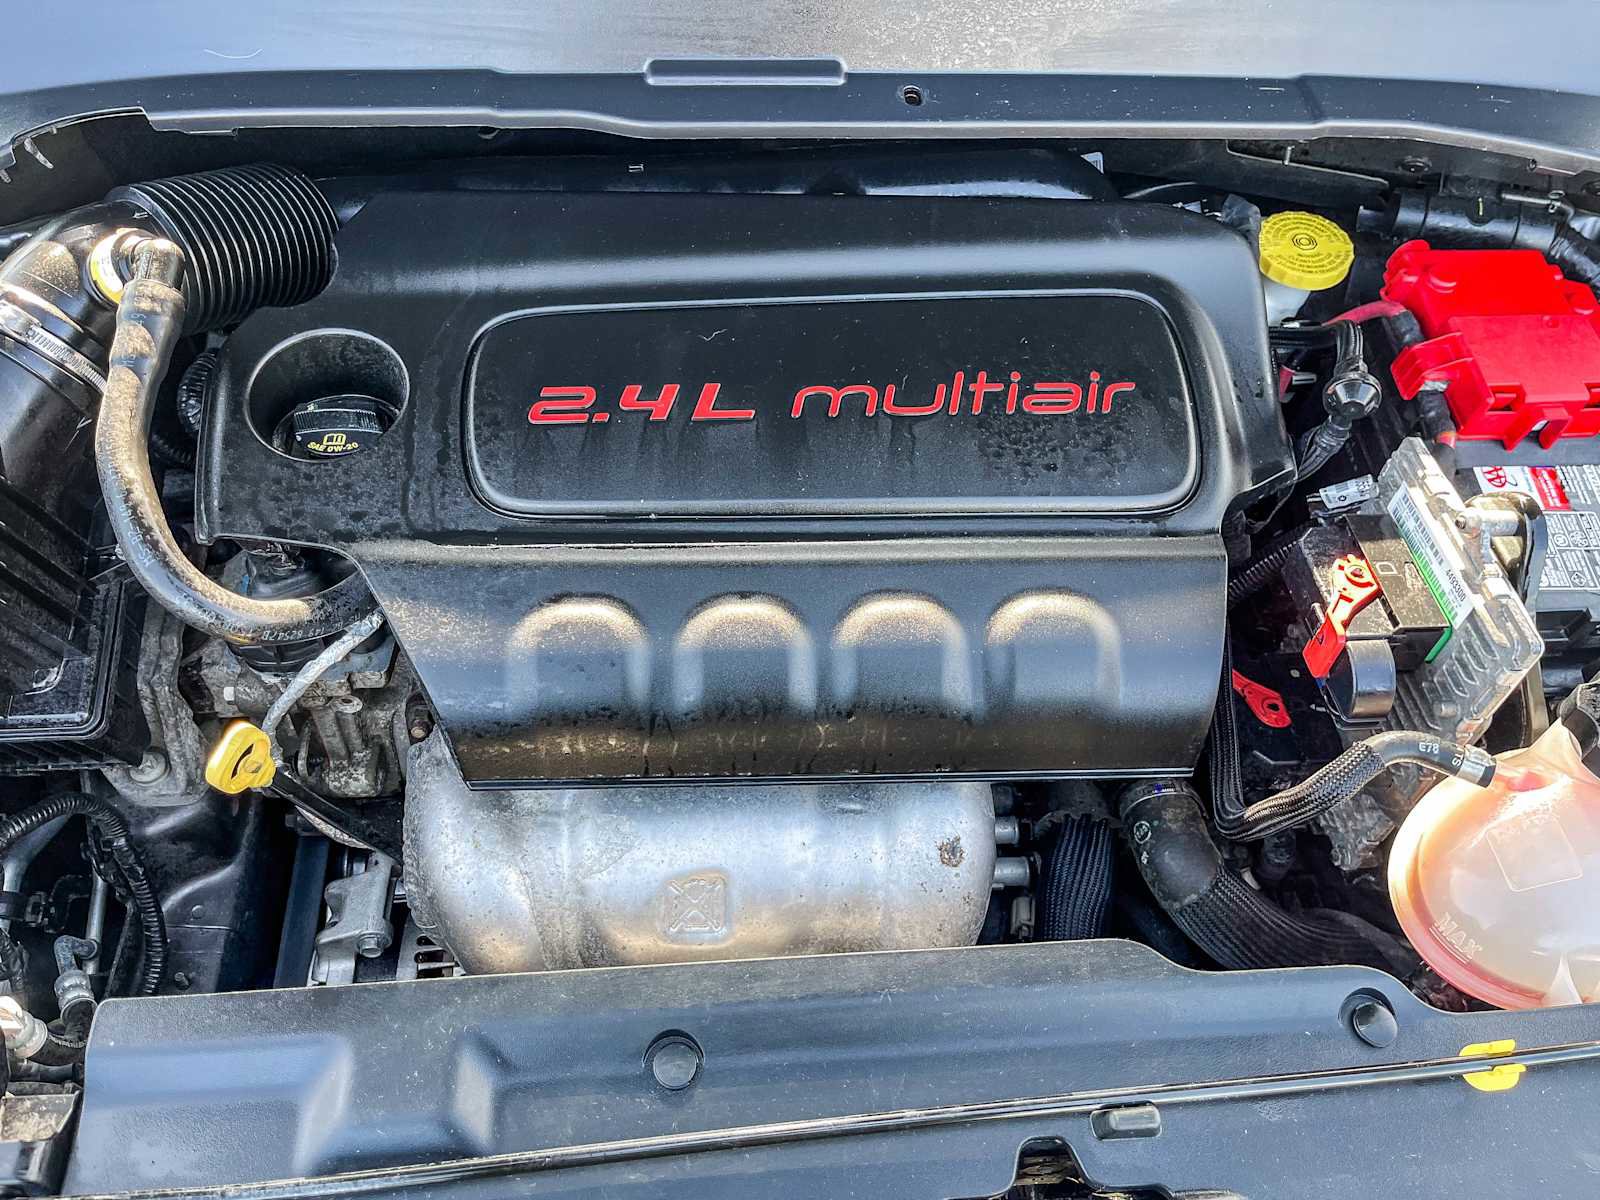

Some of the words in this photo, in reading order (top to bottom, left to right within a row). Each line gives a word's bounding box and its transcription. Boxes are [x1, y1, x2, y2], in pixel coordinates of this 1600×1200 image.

[791, 370, 1137, 419] multiair
[307, 441, 327, 452] SAE
[327, 441, 359, 453] 0W-20
[1418, 742, 1440, 755] E78
[1433, 911, 1483, 960] MAX
